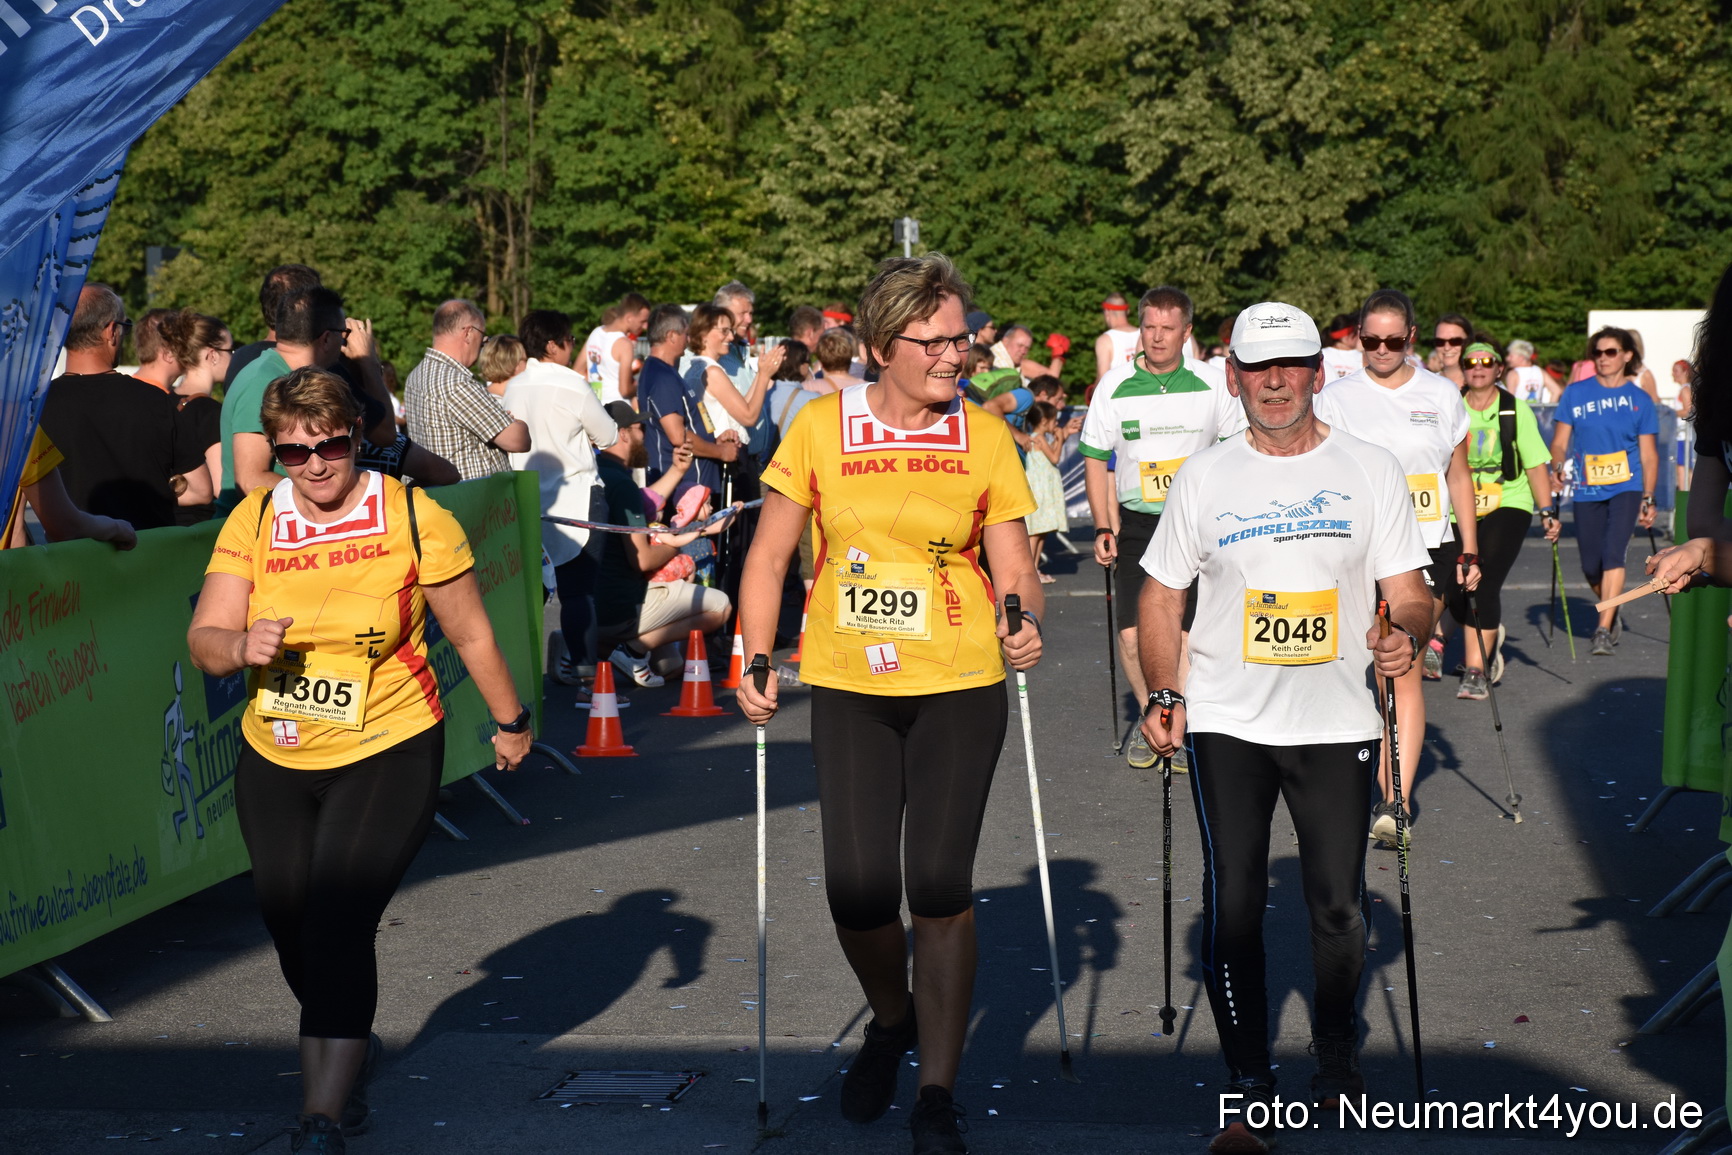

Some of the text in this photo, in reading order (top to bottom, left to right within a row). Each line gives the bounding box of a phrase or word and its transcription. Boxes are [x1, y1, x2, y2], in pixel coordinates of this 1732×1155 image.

[842, 454, 970, 477] MAX BÖGL
[1592, 463, 1622, 476] 1737
[1218, 520, 1353, 548] WECHSELSZENE
[1273, 531, 1352, 543] sportpromotion
[265, 543, 390, 574] MAX BÖGL
[845, 587, 918, 618] 1299
[855, 615, 905, 626] Nißlbeck Rita
[1254, 616, 1327, 643] 2048
[1294, 644, 1312, 652] Gerd
[273, 672, 353, 708] 1305
[273, 698, 347, 716] Regnath Roswitha
